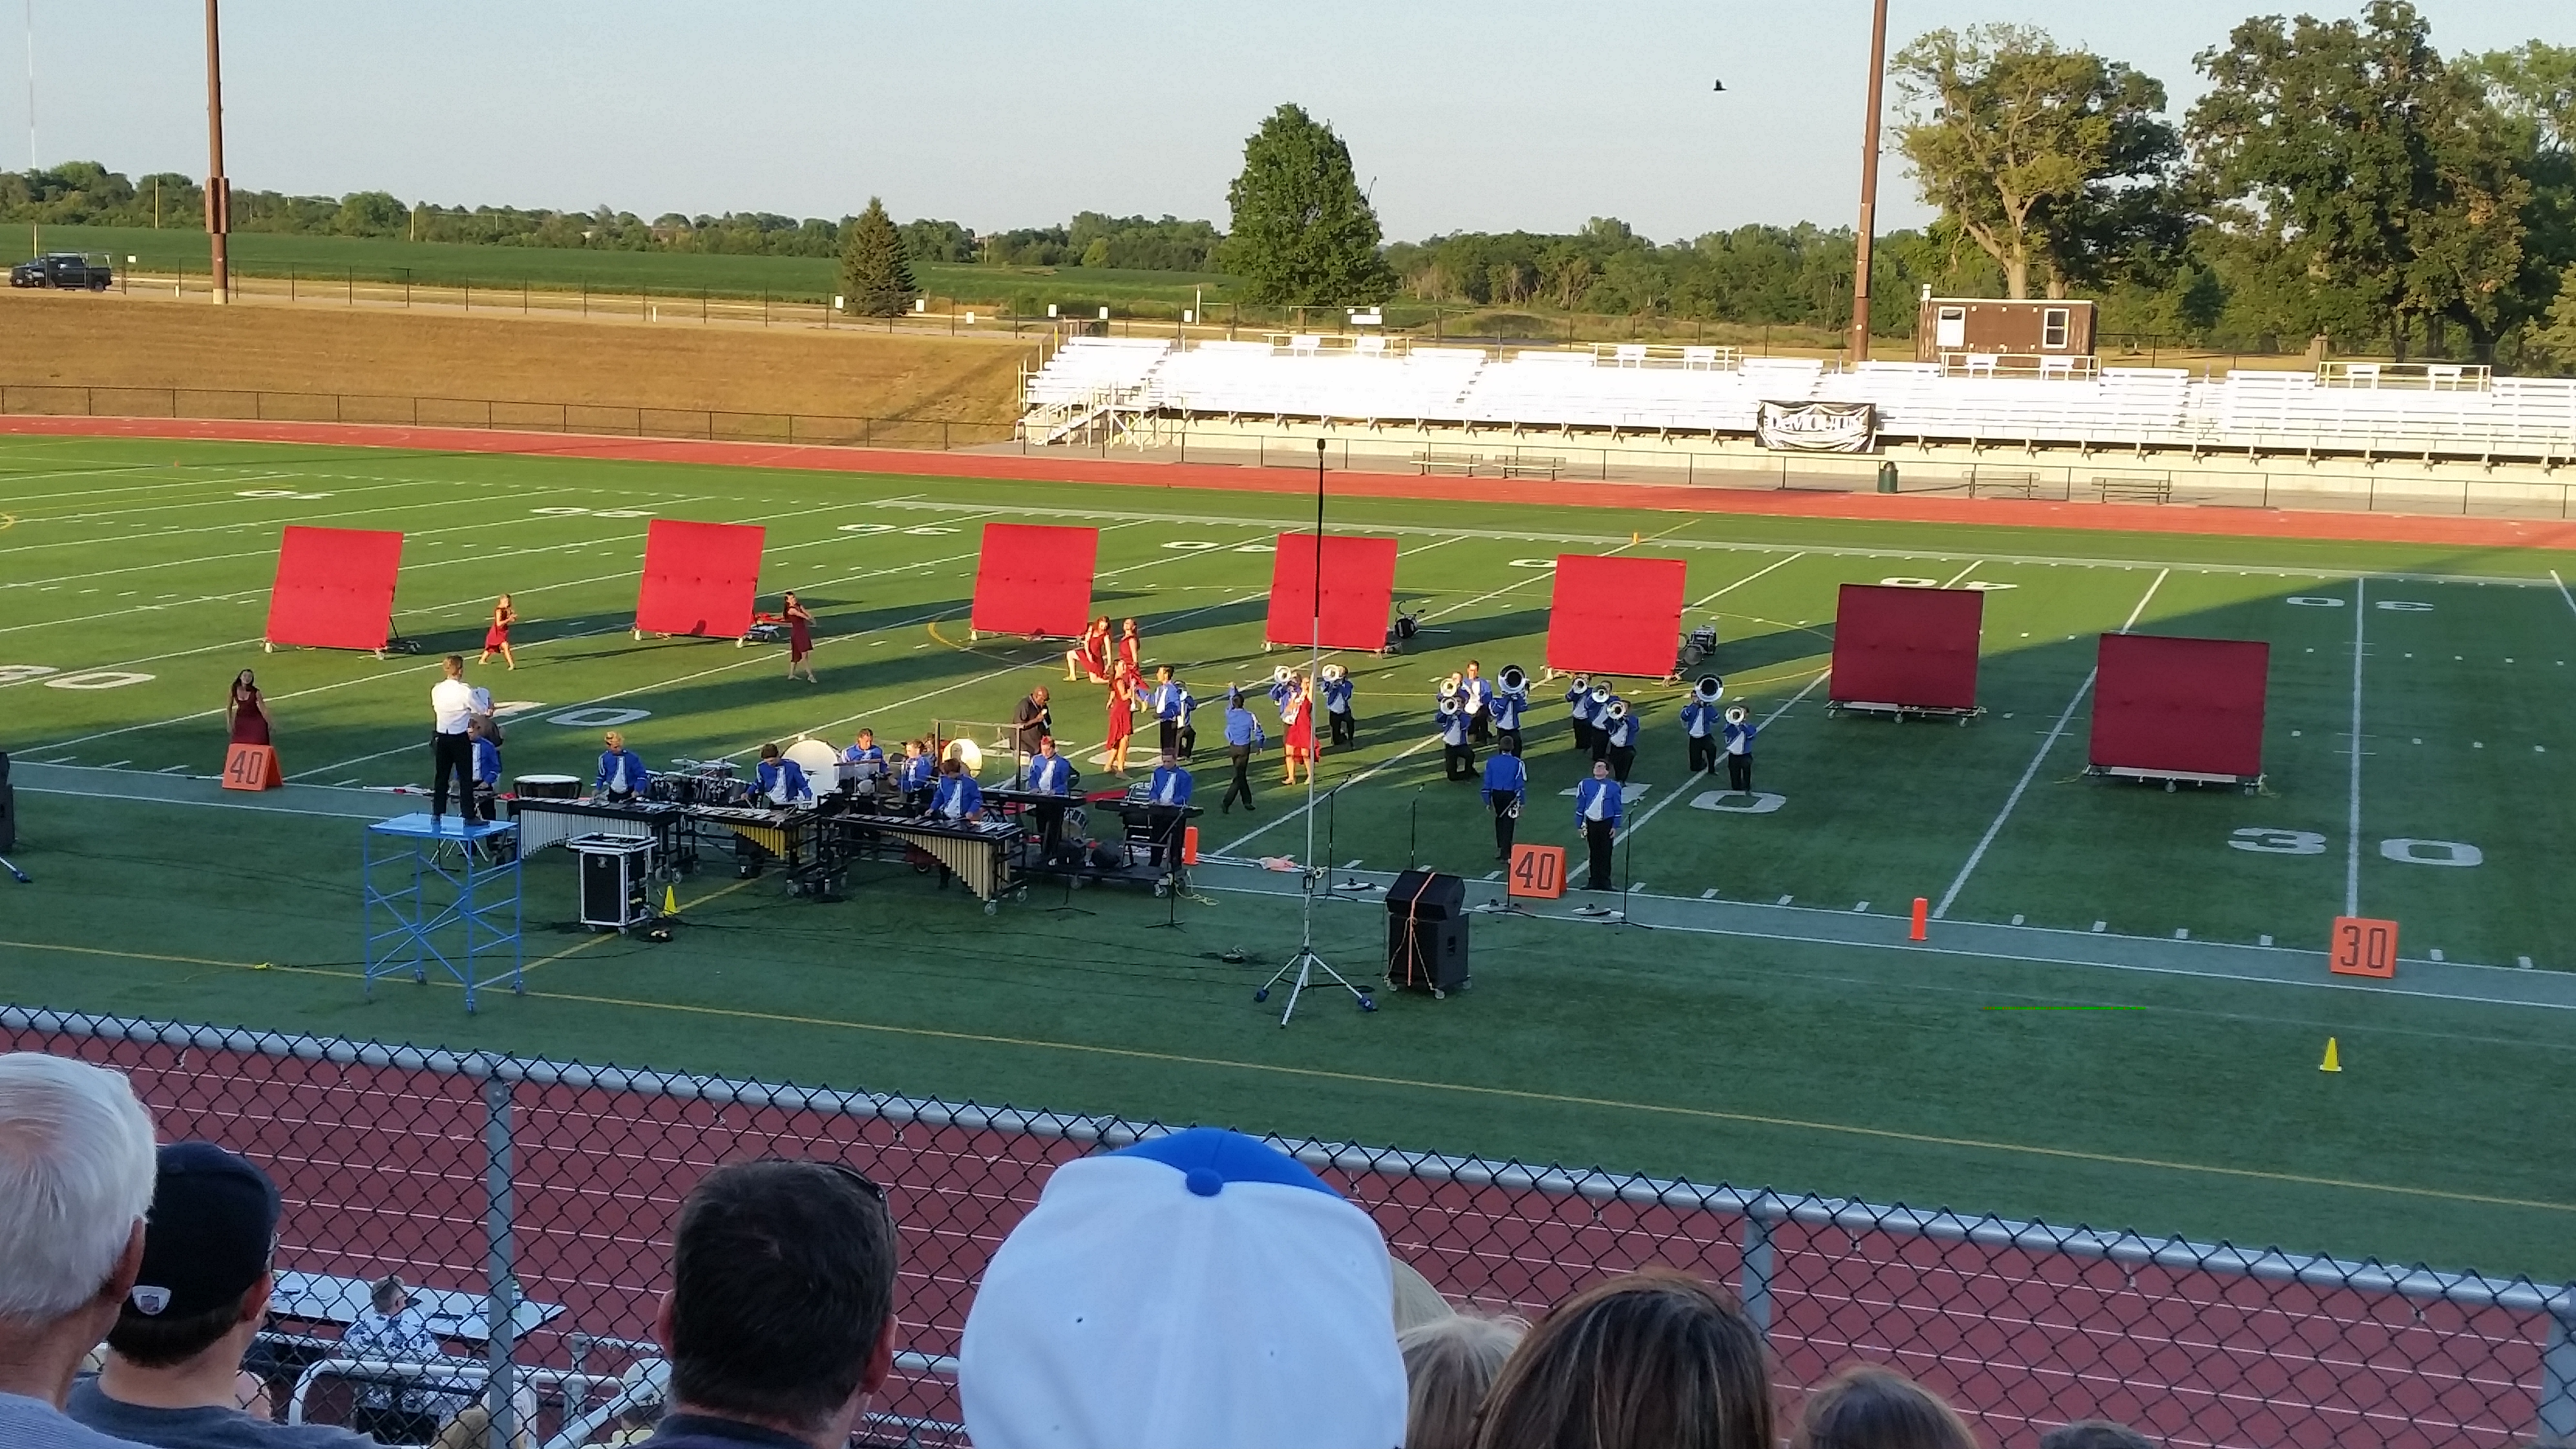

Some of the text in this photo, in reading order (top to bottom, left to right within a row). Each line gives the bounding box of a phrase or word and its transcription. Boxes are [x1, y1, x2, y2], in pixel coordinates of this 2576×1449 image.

[230, 750, 263, 784] 40
[2227, 827, 2483, 867] 30
[1515, 852, 1555, 890] 40
[2340, 925, 2387, 969] 30
